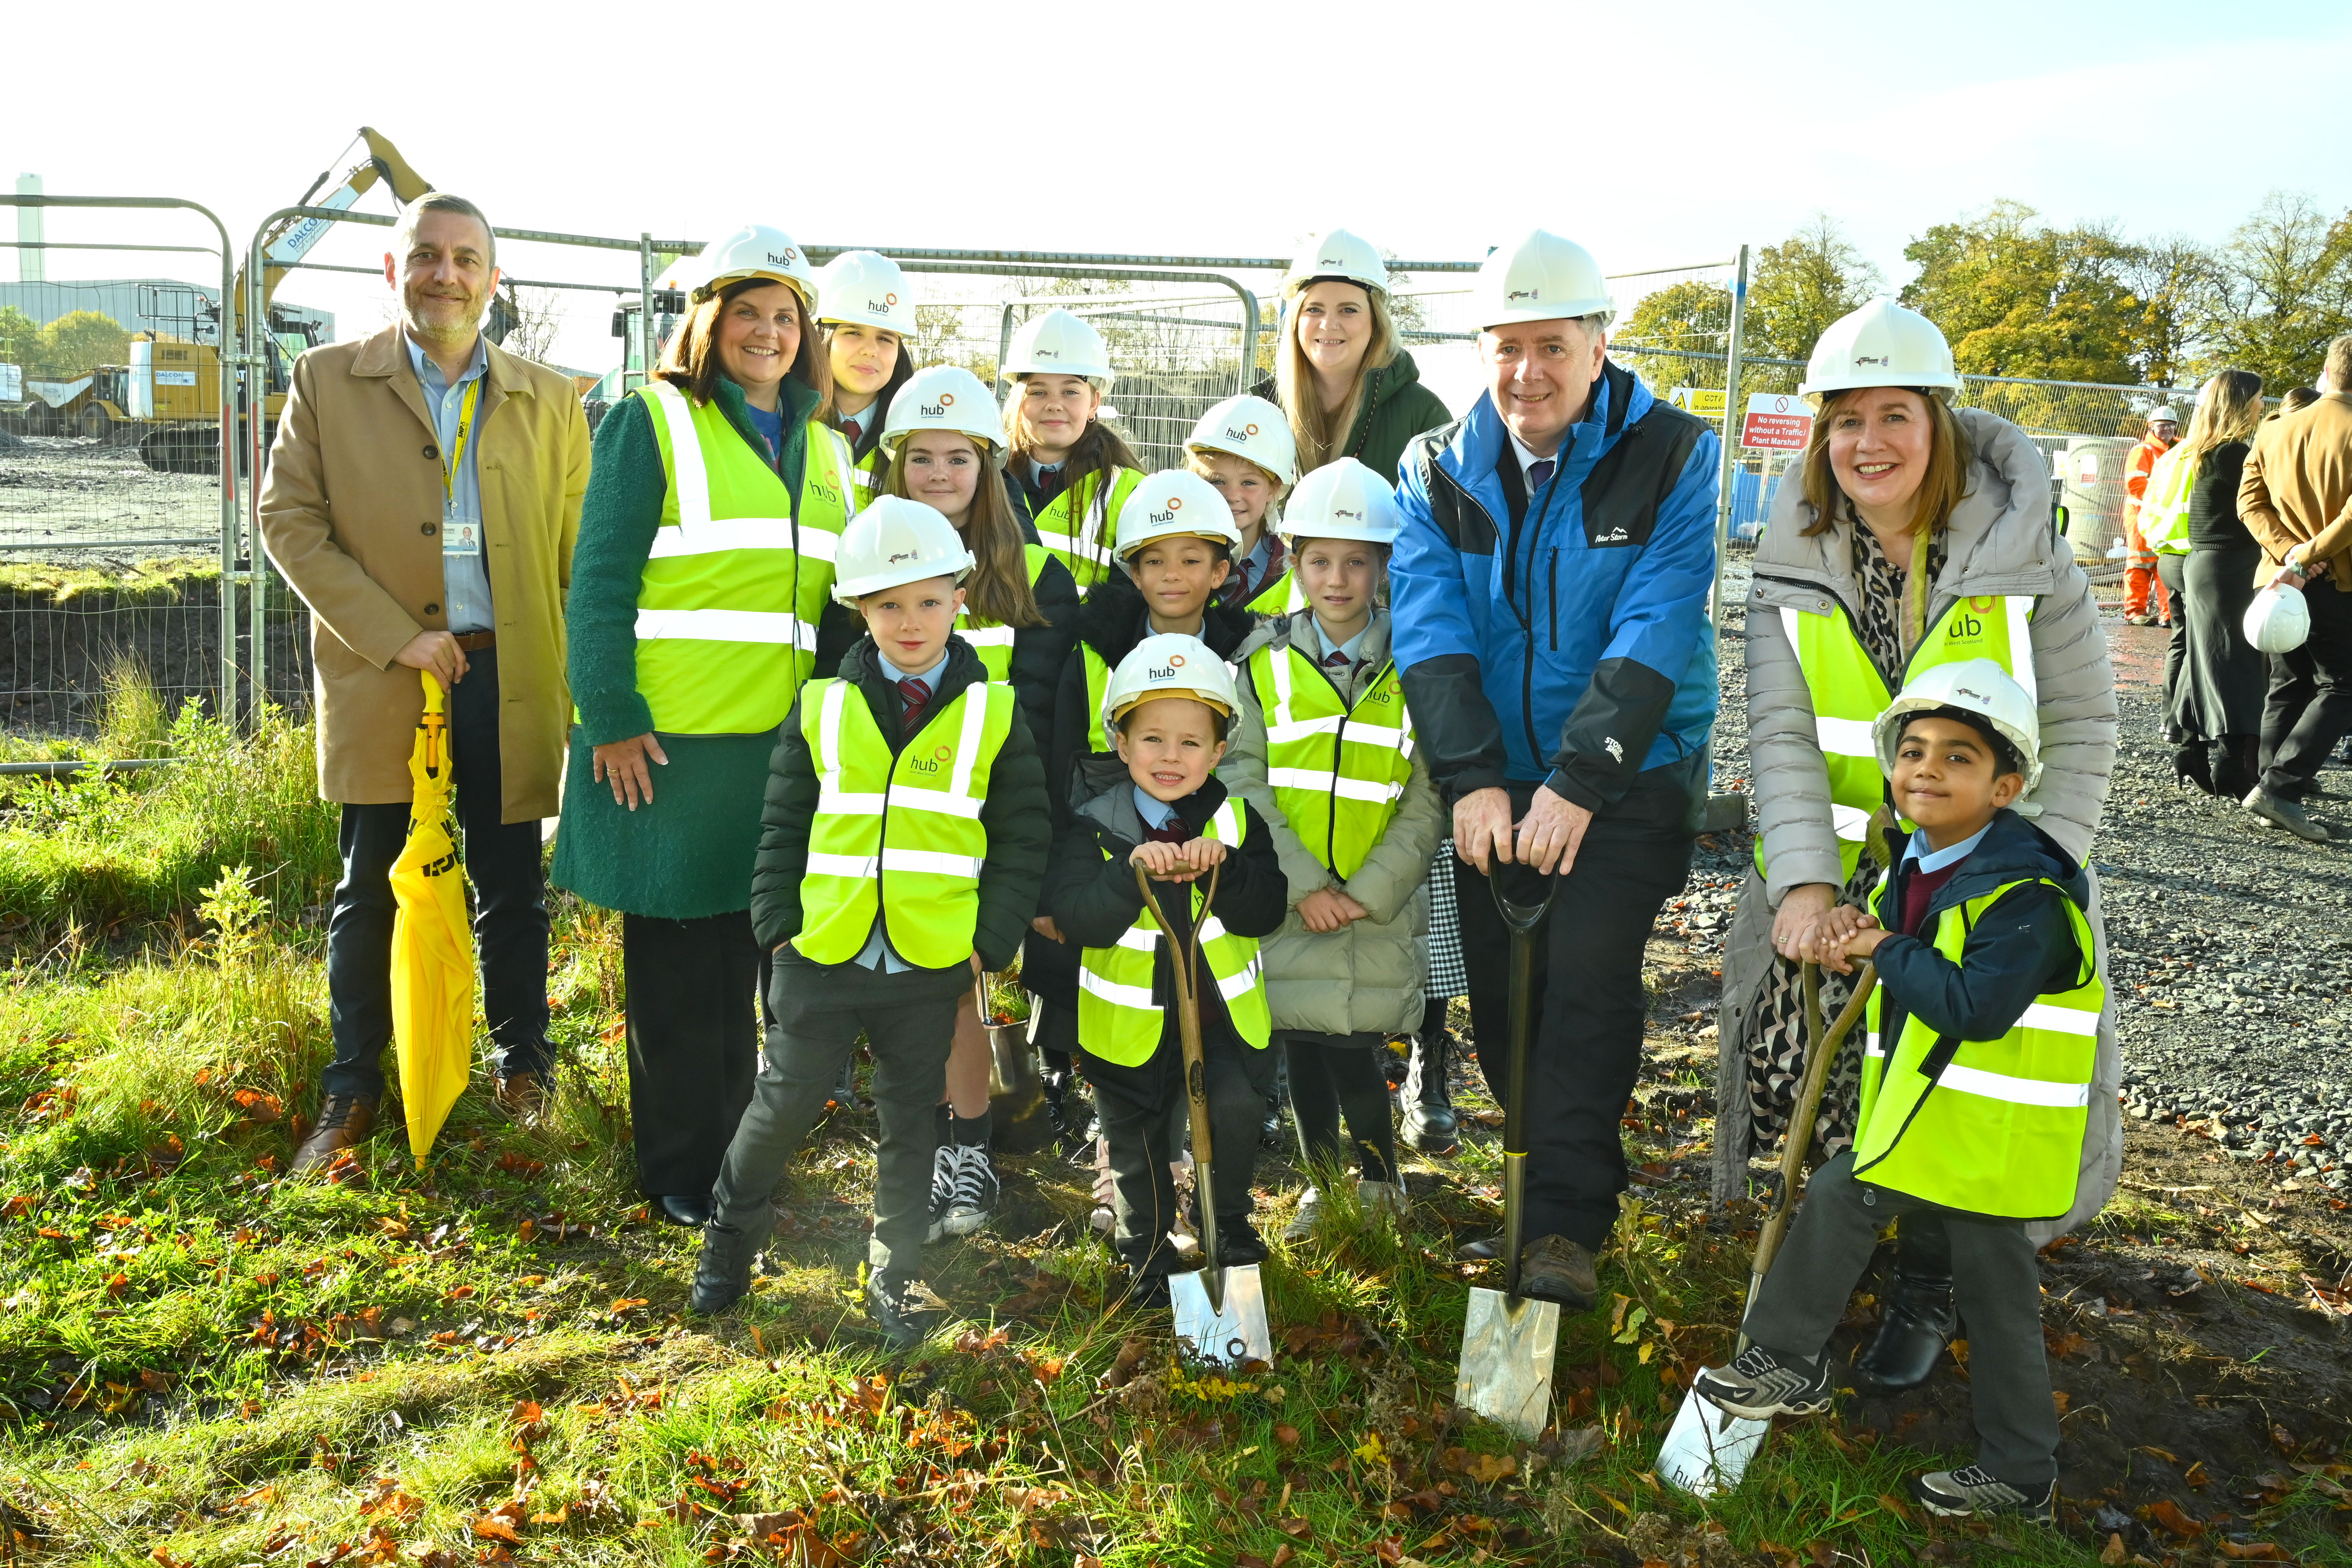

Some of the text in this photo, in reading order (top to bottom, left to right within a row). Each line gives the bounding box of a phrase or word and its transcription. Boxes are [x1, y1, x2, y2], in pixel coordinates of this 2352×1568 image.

[287, 218, 323, 248] DALCO
[768, 252, 789, 266] hub
[869, 300, 889, 313] hub
[921, 404, 944, 415] hub
[1769, 418, 1800, 427] reversing
[1226, 427, 1247, 441] hub
[1749, 426, 1774, 434] without
[1782, 428, 1806, 436] Traffic/
[1751, 436, 1800, 446] Plant Marshall
[809, 480, 836, 502] hub
[1049, 505, 1070, 520] hub
[1150, 510, 1174, 524] hub
[1595, 535, 1610, 543] Peter
[1949, 614, 1981, 638] ub
[1150, 666, 1175, 679] hub
[1605, 736, 1624, 755] STORM
[910, 755, 938, 772] hub
